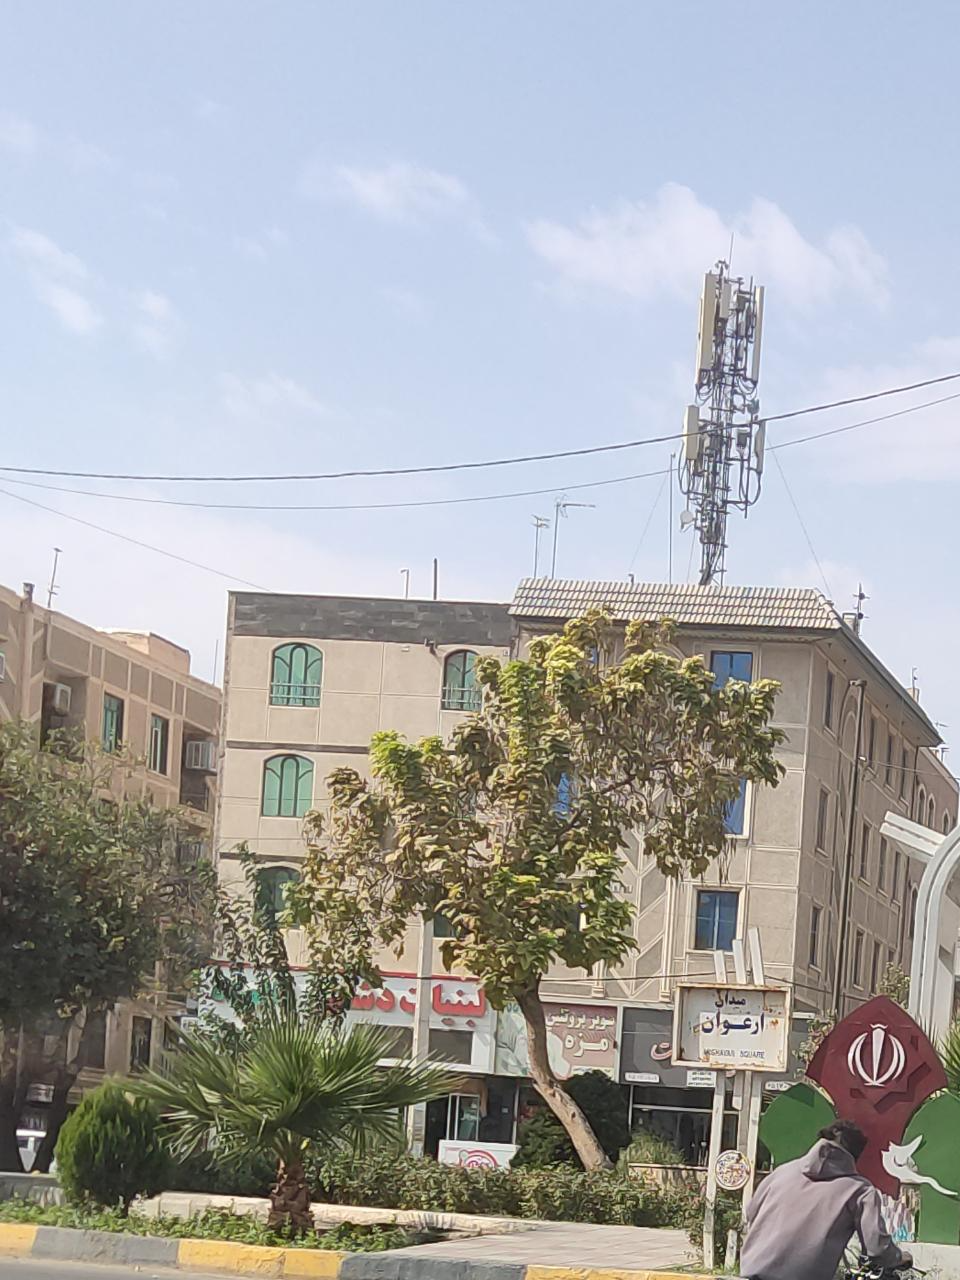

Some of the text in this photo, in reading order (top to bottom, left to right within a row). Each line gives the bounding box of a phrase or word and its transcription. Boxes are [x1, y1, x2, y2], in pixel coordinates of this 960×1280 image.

[714, 991, 747, 1009] میدان
[701, 1010, 765, 1036] ارغوان
[564, 1032, 609, 1057] مزه
